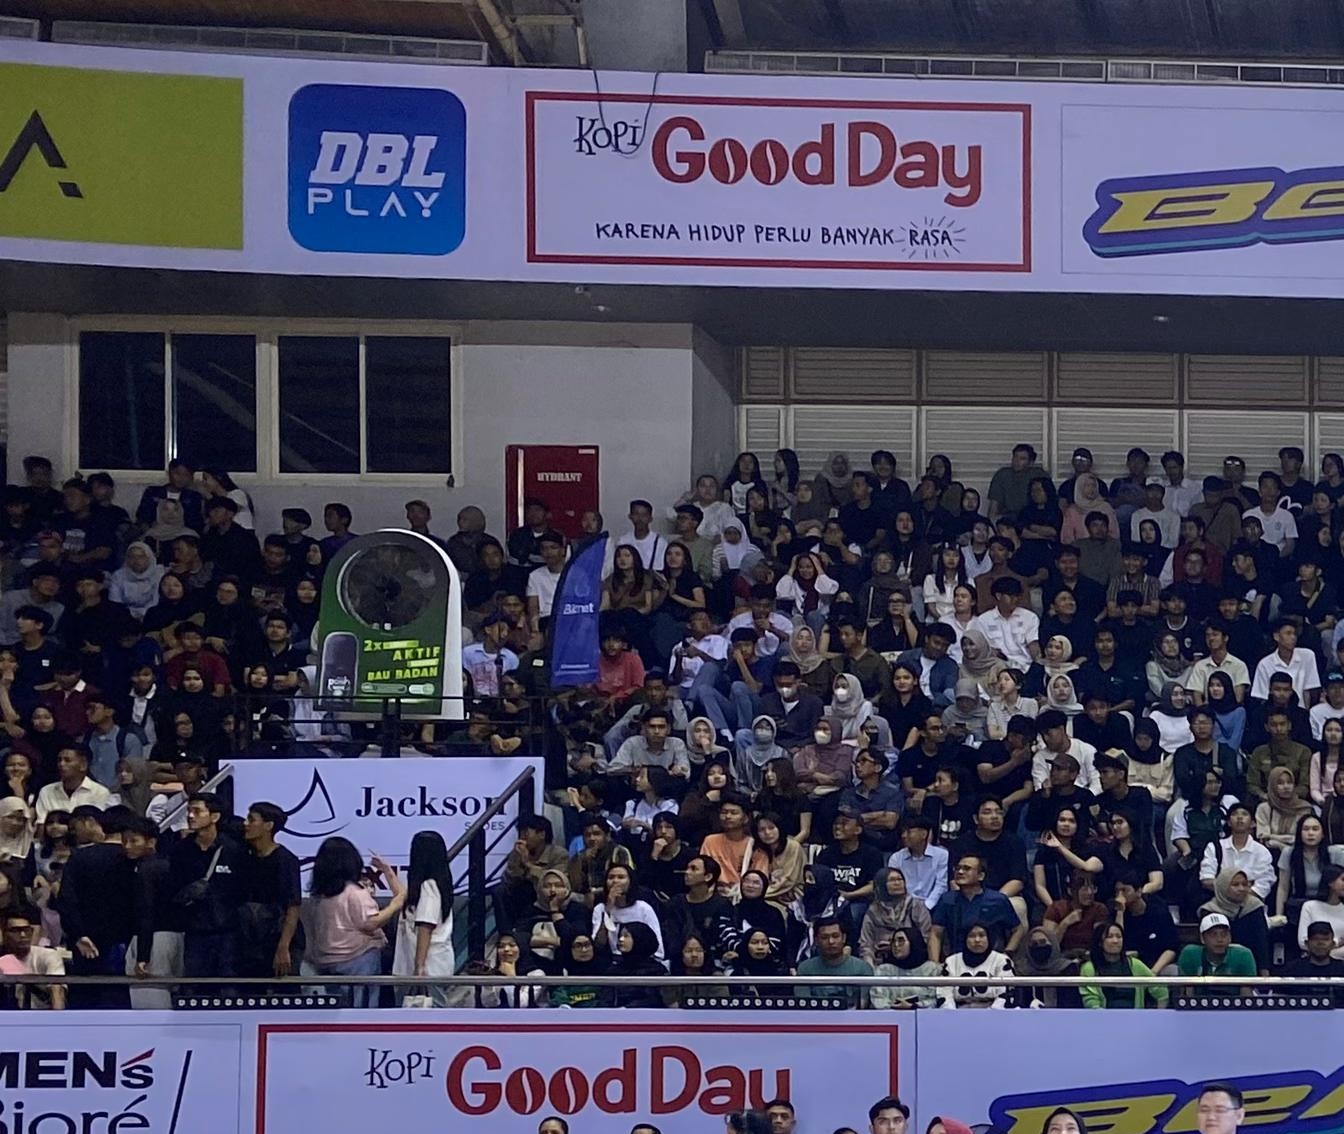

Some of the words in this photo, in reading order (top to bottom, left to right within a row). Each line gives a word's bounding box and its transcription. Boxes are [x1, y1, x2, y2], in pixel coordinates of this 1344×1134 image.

[310, 131, 446, 188] DBL
[652, 116, 834, 187] Good
[848, 122, 982, 207] Day
[308, 190, 439, 218] PLAY
[596, 222, 679, 241] KARENA
[688, 224, 746, 243] HIDUP
[755, 224, 811, 244] PERLU
[821, 226, 895, 246] BANYAK
[909, 229, 953, 247] RASA
[537, 472, 582, 482] HYDRANT
[393, 647, 441, 661] AKTIF
[464, 821, 505, 831] SOES
[446, 1045, 637, 1115] Good
